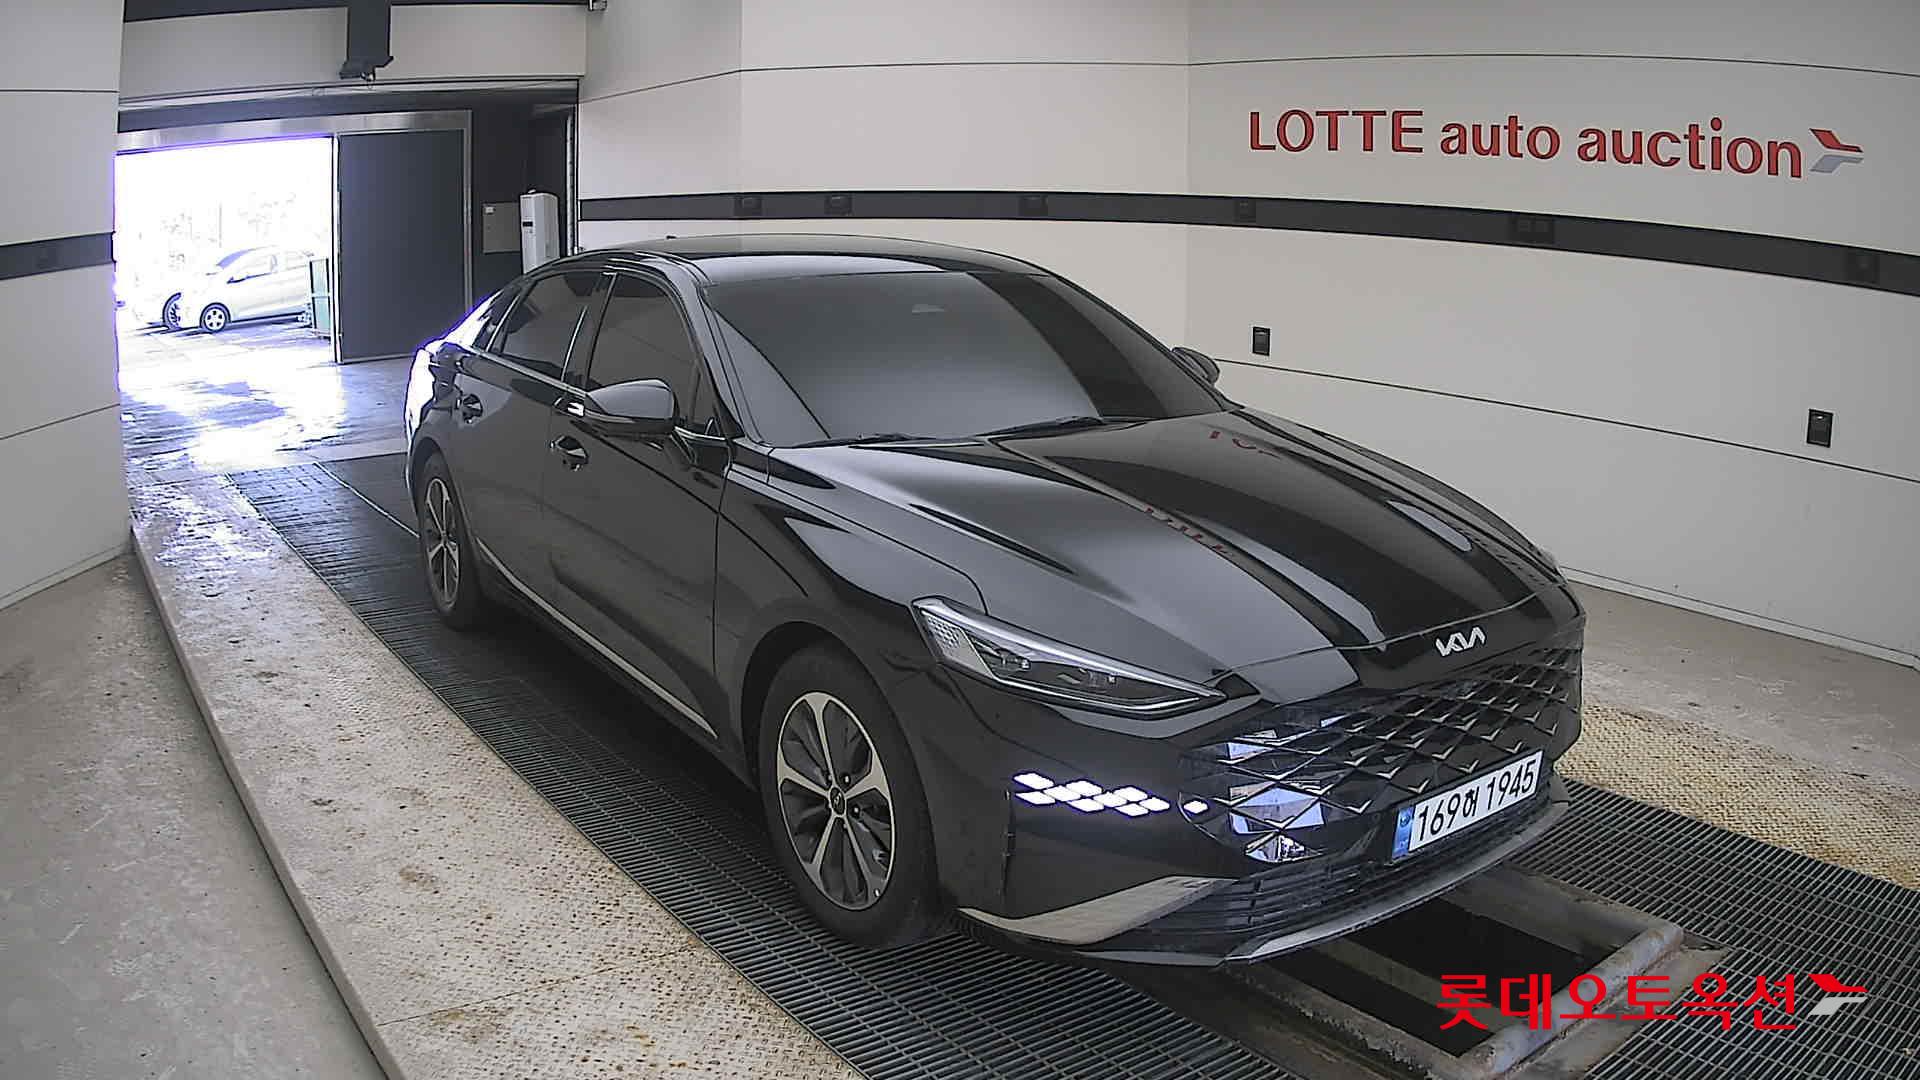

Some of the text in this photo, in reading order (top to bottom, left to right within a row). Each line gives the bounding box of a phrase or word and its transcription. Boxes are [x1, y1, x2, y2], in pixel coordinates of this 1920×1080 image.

[1249, 109, 1802, 179] LOTTE auto auction
[1487, 758, 1537, 811] 1945
